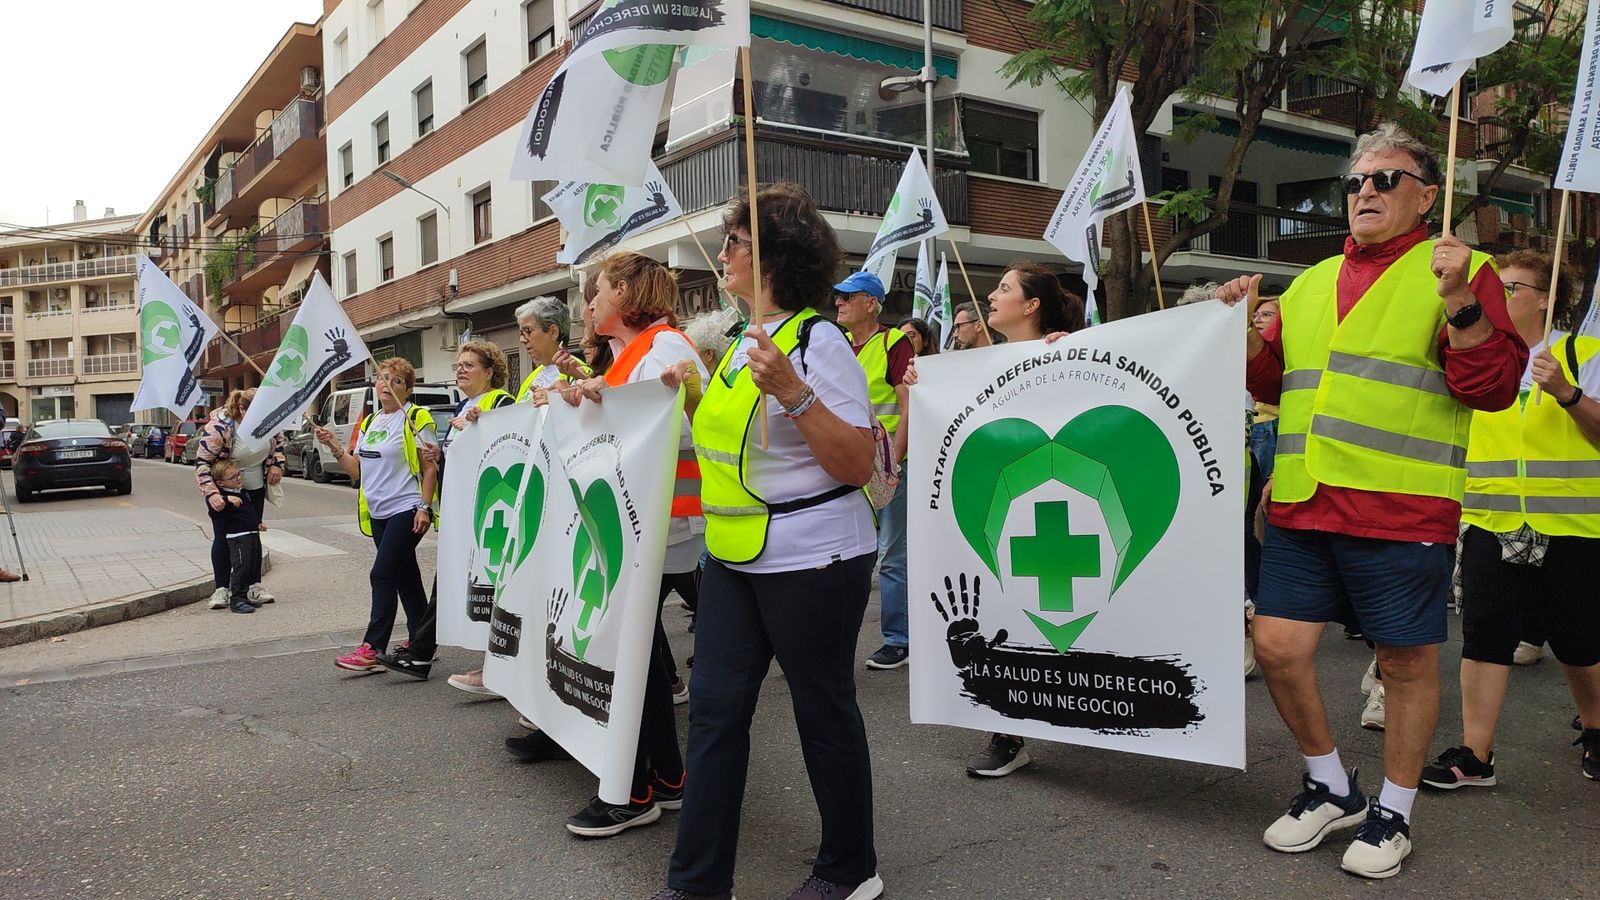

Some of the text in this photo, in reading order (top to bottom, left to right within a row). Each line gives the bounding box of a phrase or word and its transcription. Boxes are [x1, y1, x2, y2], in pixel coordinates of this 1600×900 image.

[992, 370, 1127, 411] AGUILAR DE LA FRONTERA
[930, 348, 1225, 510] PLATAFORMA EN DEFENSA DE LA SANIDAD PÚBLICA
[970, 662, 1182, 700] ¡LA SALUD ES UN DERECHO,
[1008, 688, 1136, 718] NO UN NEGOCIO!
